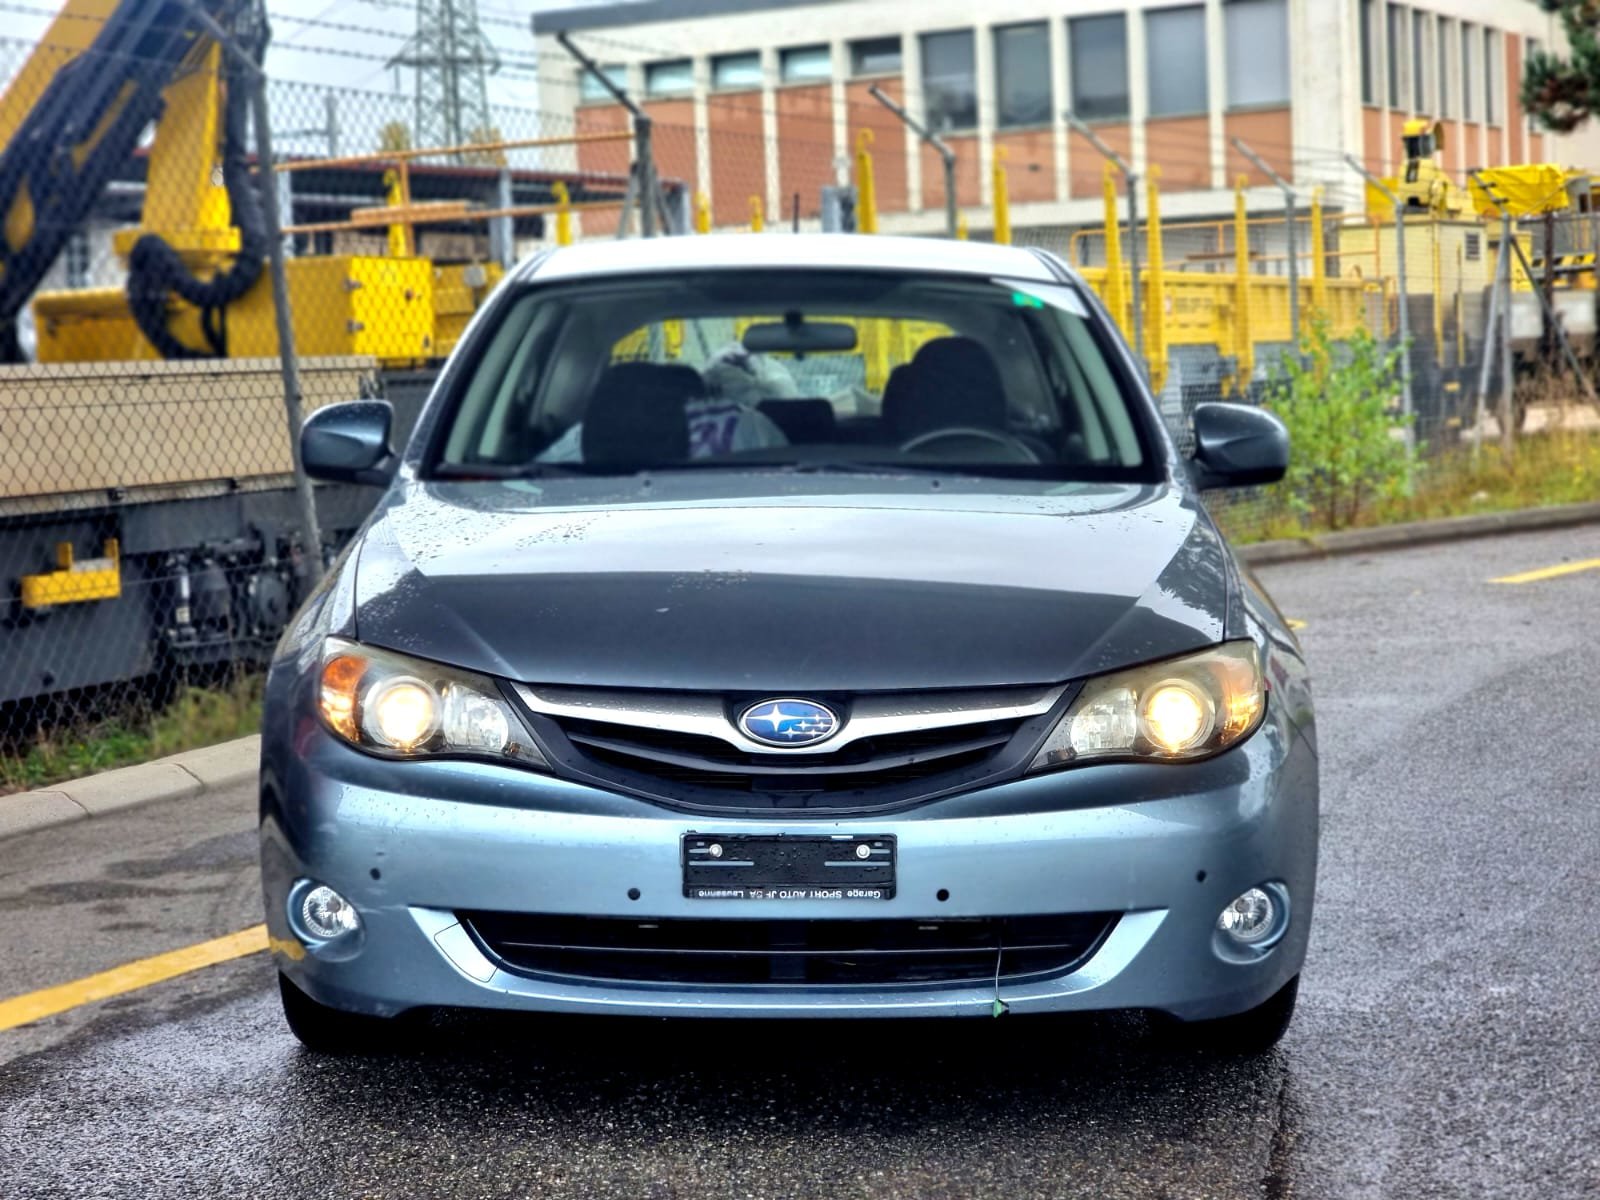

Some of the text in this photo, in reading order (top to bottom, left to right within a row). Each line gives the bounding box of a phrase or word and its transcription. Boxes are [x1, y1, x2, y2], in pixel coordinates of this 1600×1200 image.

[779, 890, 806, 899] AUTO
[809, 890, 842, 899] SPORT
[847, 889, 880, 899] Garage
